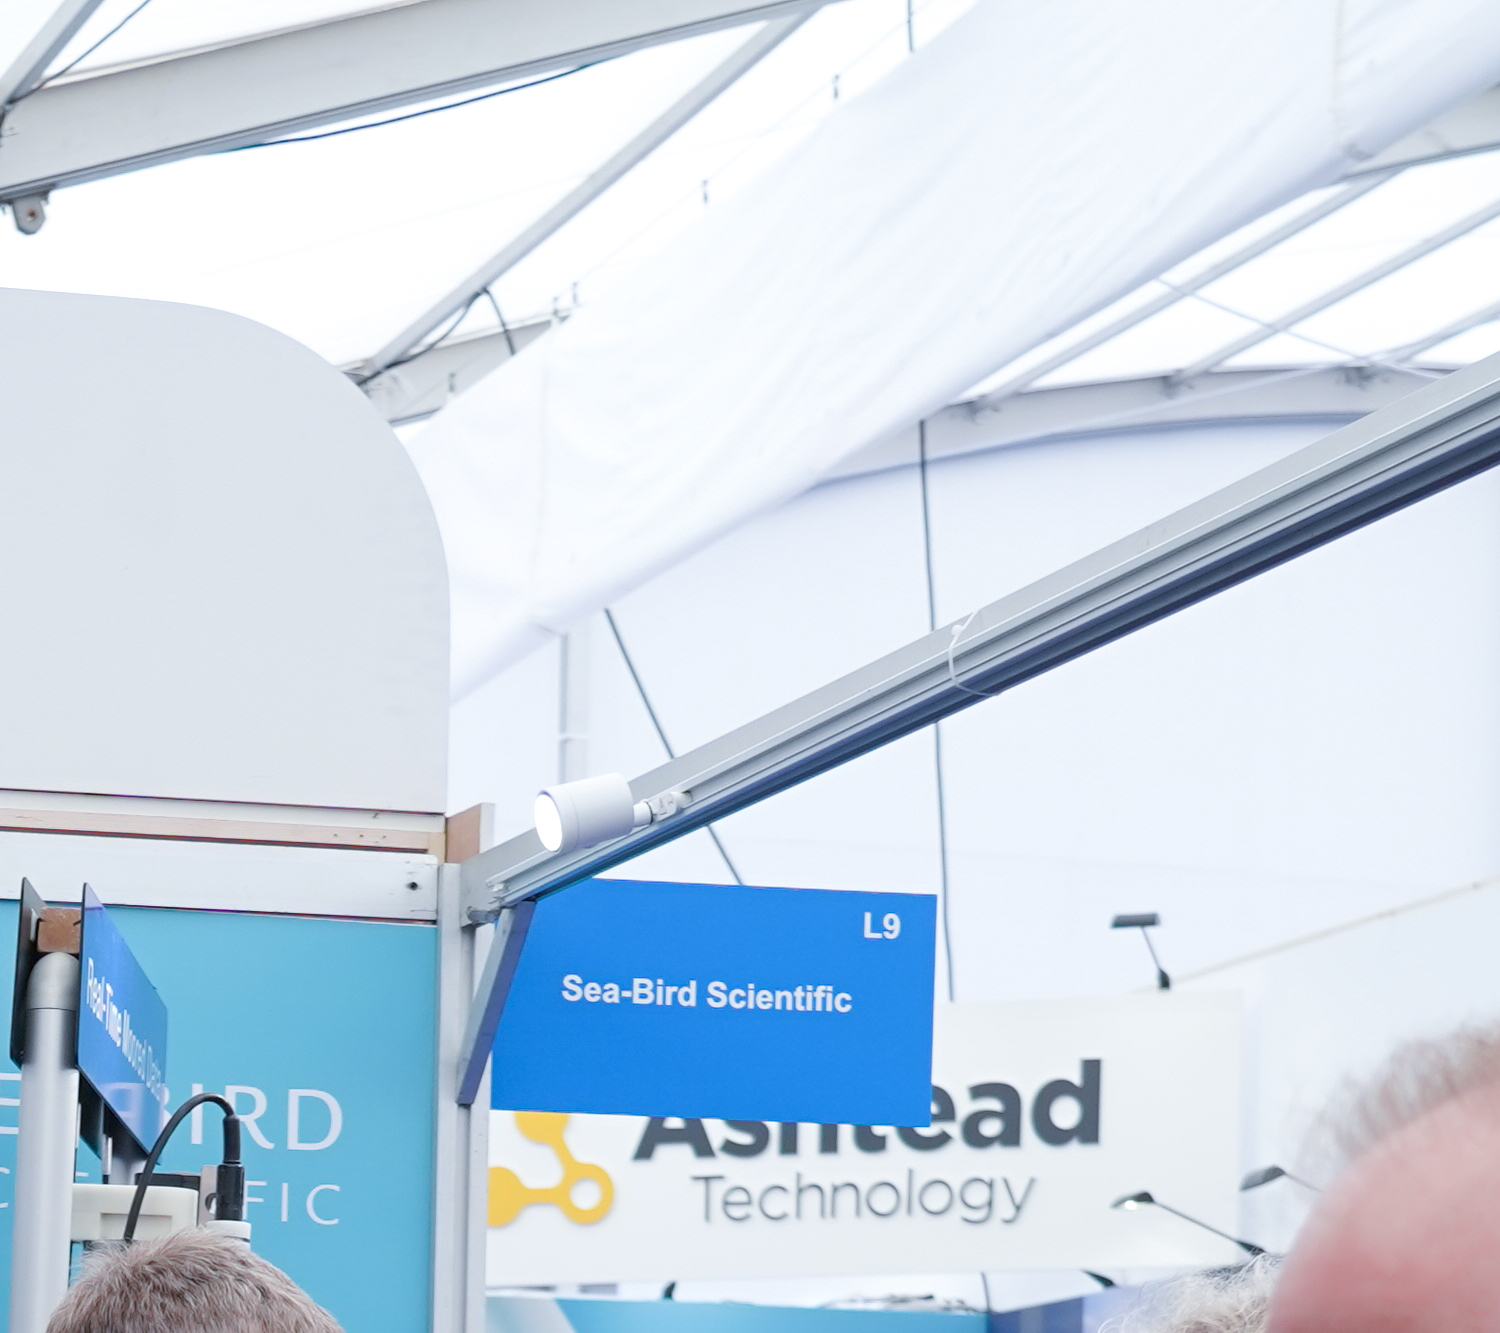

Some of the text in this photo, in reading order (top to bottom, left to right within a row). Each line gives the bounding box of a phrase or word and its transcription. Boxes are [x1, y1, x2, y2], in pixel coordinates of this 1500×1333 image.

[862, 911, 902, 942] L9
[561, 973, 853, 1014] Sea-Bird Scientific
[692, 1168, 1037, 1225] Technology
